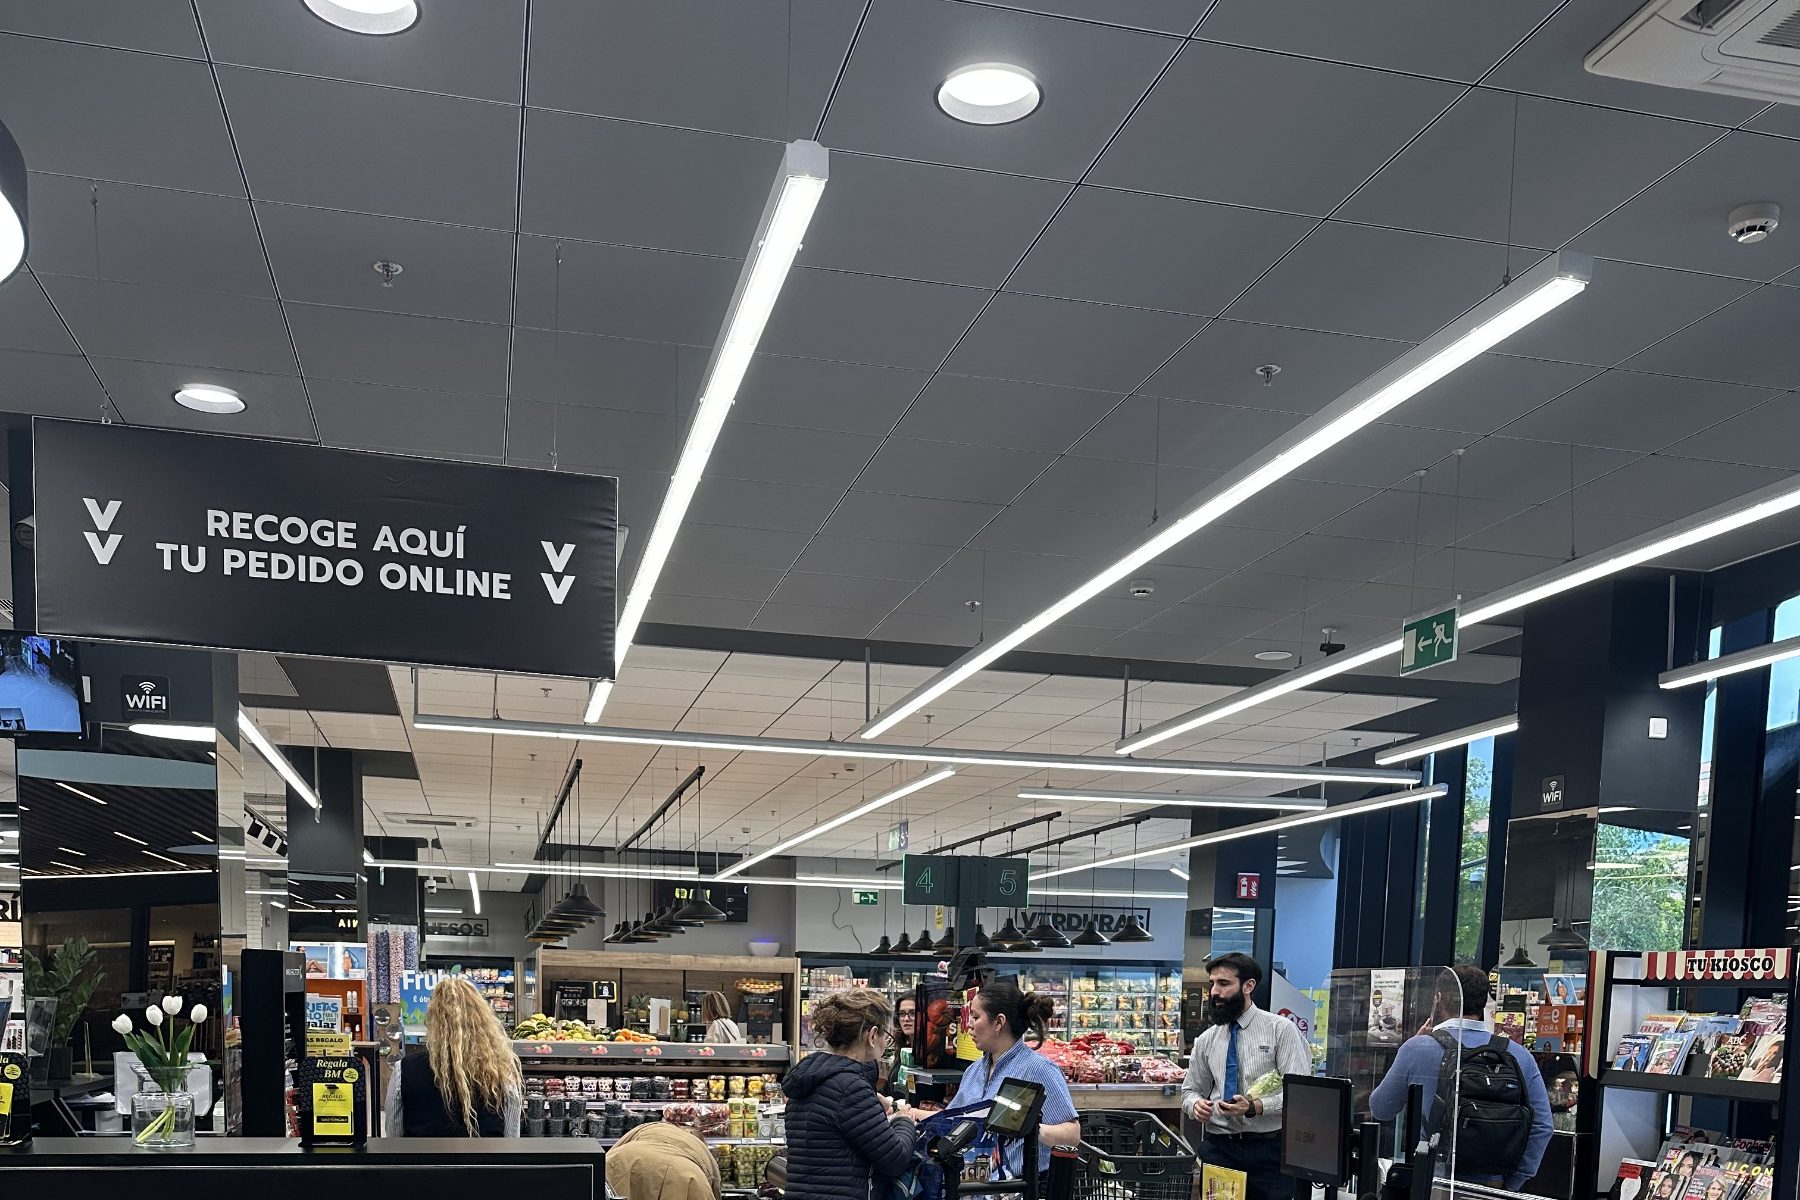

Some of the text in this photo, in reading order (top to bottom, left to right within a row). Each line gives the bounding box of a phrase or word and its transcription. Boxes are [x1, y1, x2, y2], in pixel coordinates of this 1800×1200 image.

[206, 509, 466, 559] RECOGE AQUÍ
[155, 542, 512, 600] TU PEDIDO ONLINE
[915, 866, 934, 894] 4
[999, 869, 1017, 896] 5
[1688, 957, 1774, 972] TU KIOSCO
[1727, 1031, 1747, 1045] ABC
[316, 1059, 348, 1069] Regala
[324, 1069, 342, 1079] BM
